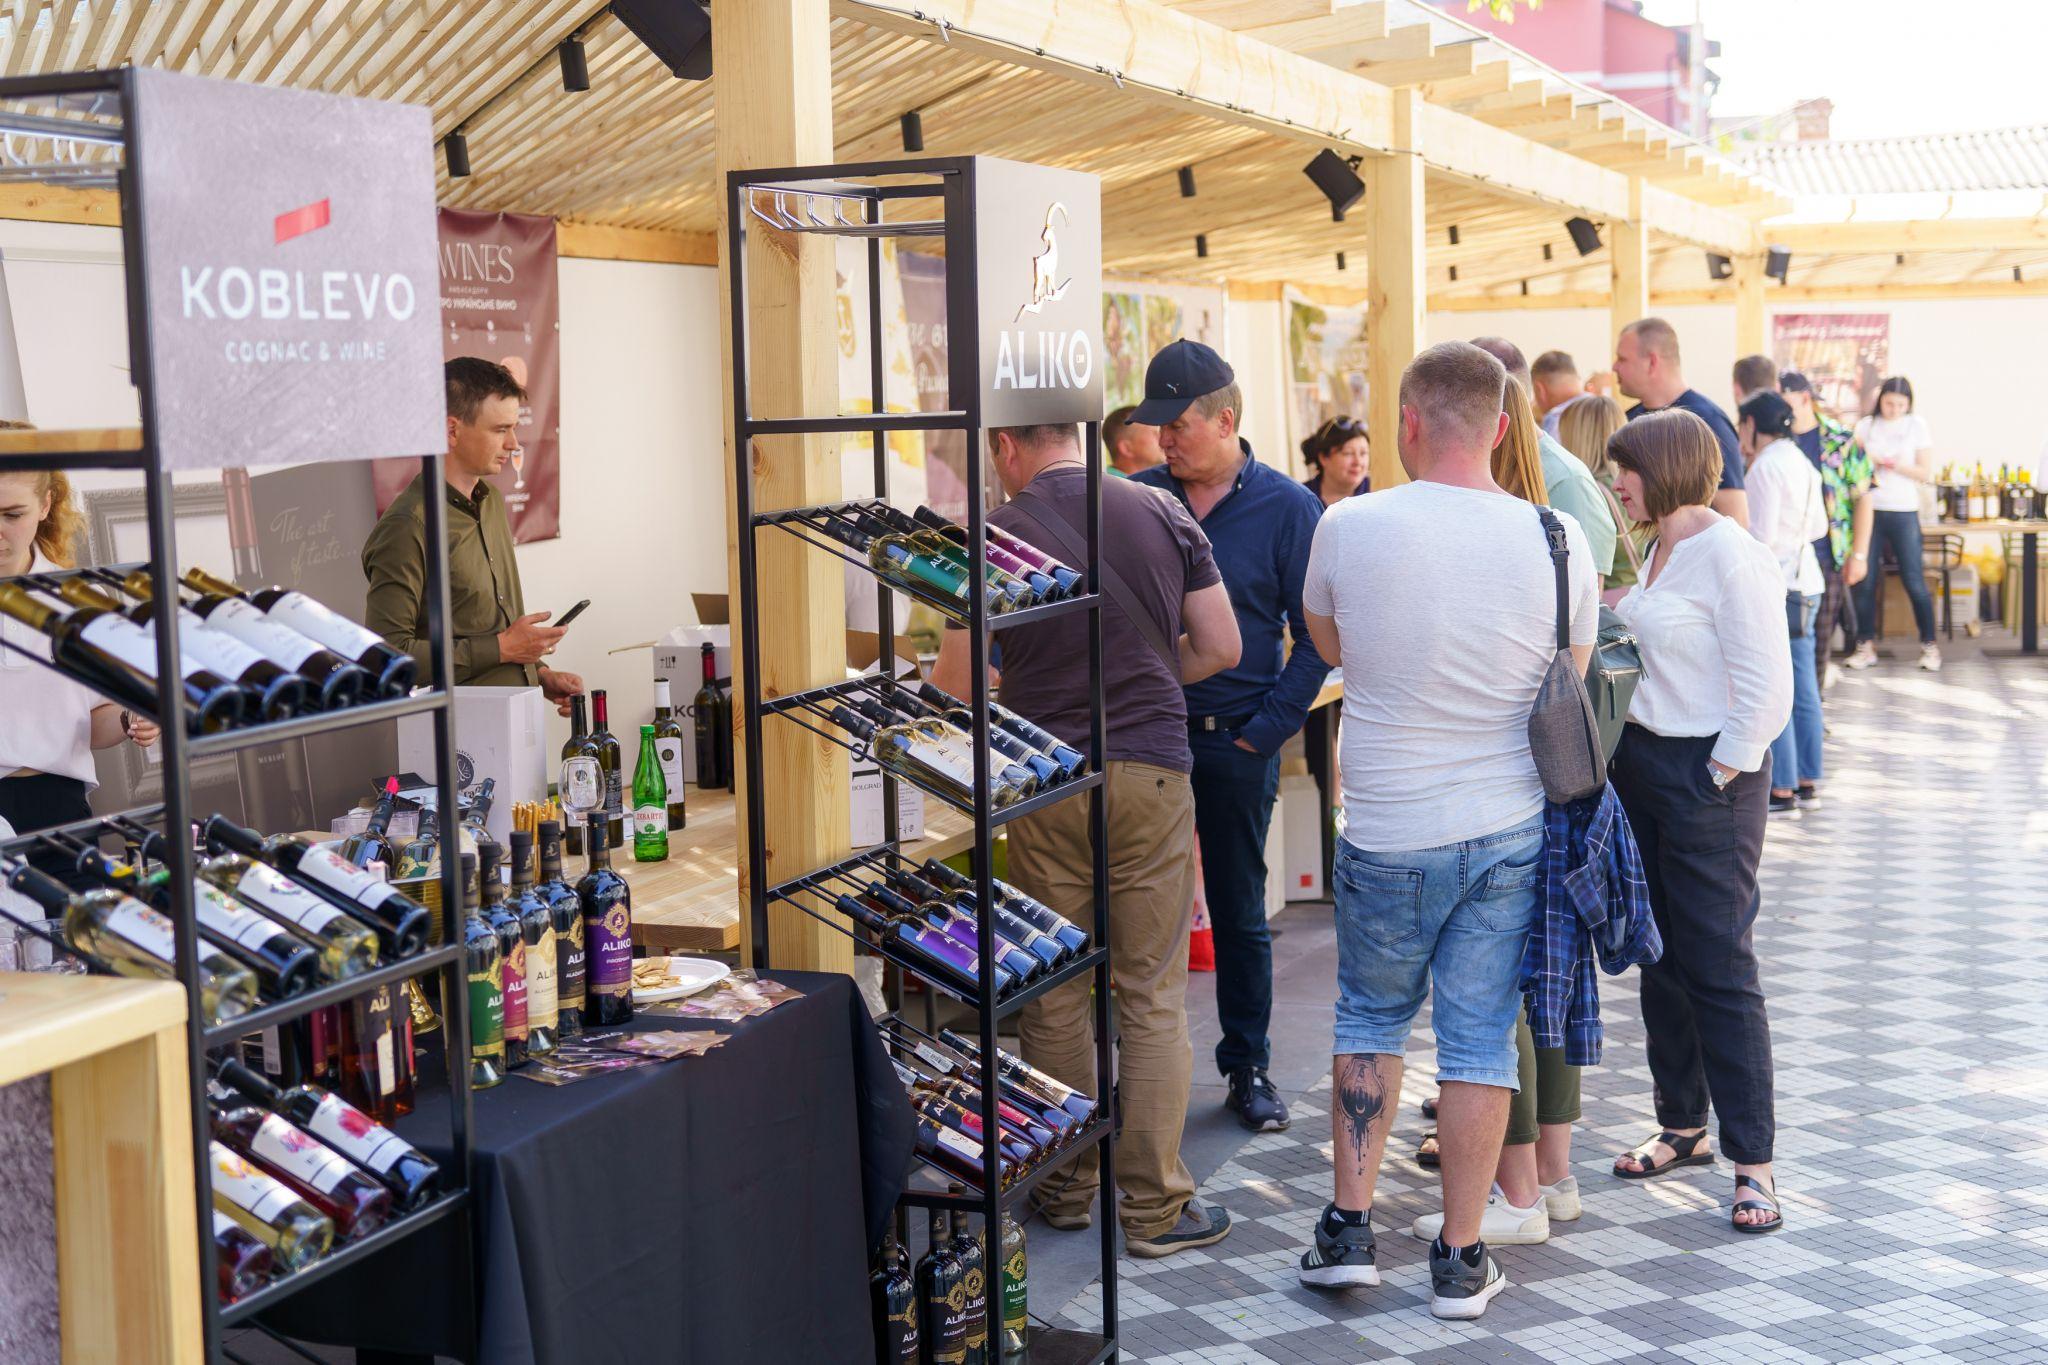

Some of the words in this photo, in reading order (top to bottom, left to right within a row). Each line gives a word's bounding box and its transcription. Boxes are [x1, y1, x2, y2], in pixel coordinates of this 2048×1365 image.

[438, 242, 514, 284] WINES
[181, 265, 416, 321] KOBLEVO
[225, 341, 311, 363] COGNAC
[319, 341, 330, 361] &
[340, 341, 386, 361] WINE
[993, 329, 1092, 389] ALIKO
[271, 507, 303, 543] The
[602, 938, 631, 951] ALIKO
